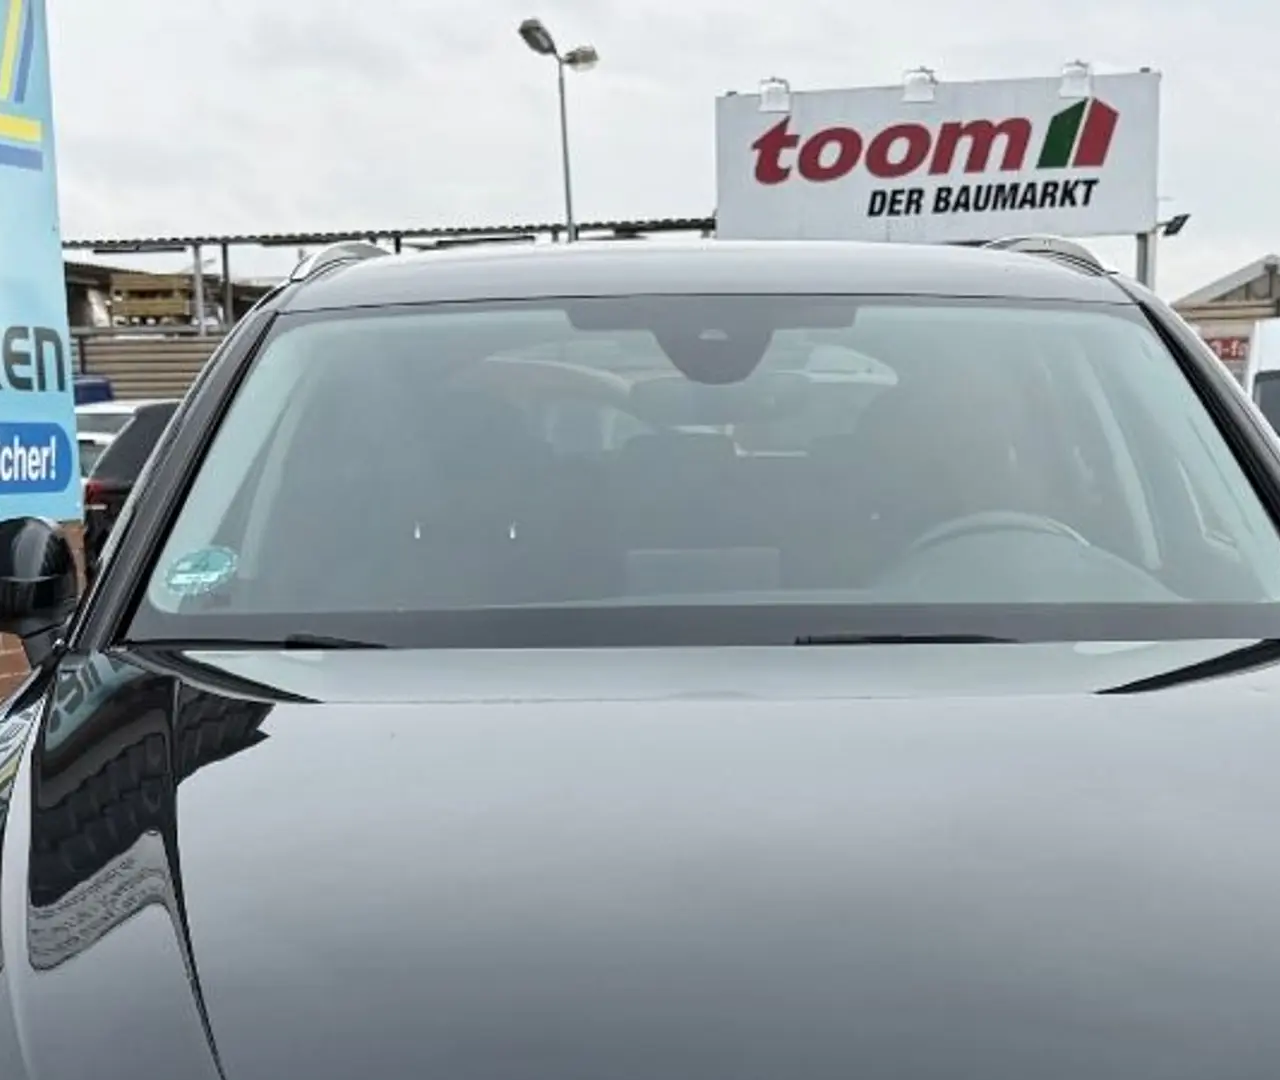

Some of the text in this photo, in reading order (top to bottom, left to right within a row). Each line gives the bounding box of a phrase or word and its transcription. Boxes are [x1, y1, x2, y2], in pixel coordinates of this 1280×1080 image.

[751, 115, 1033, 185] toom
[867, 179, 1099, 217] DER BAUMARKT
